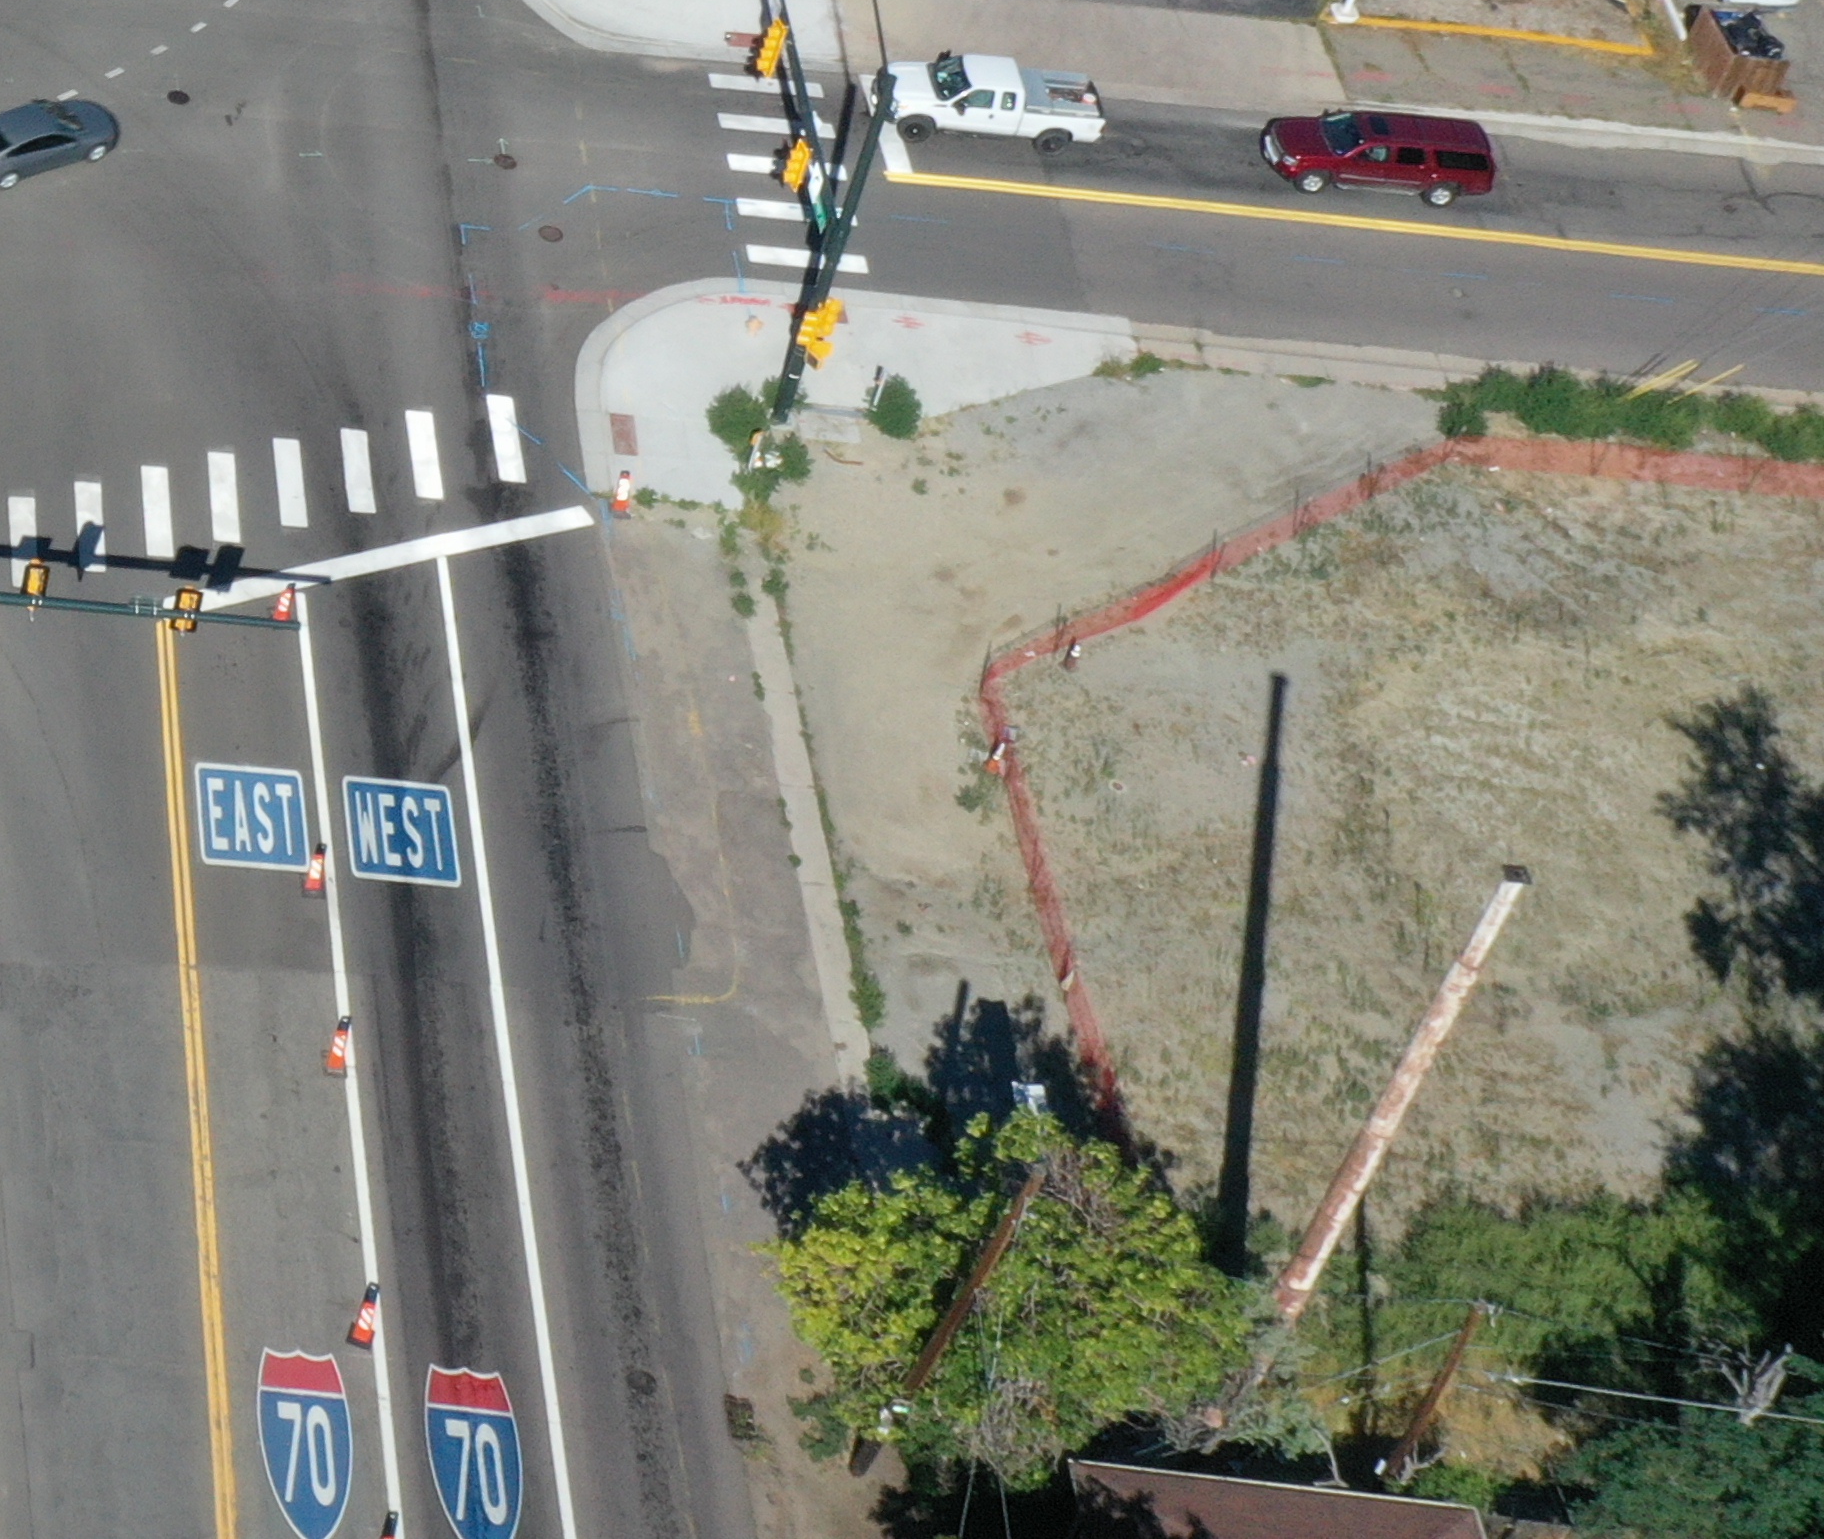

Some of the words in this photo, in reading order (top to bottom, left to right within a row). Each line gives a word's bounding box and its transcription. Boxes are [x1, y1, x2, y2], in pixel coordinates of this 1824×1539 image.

[205, 776, 293, 856] EAST
[355, 790, 444, 872] WEST
[277, 1401, 337, 1507] 70
[444, 1418, 508, 1526] 70
